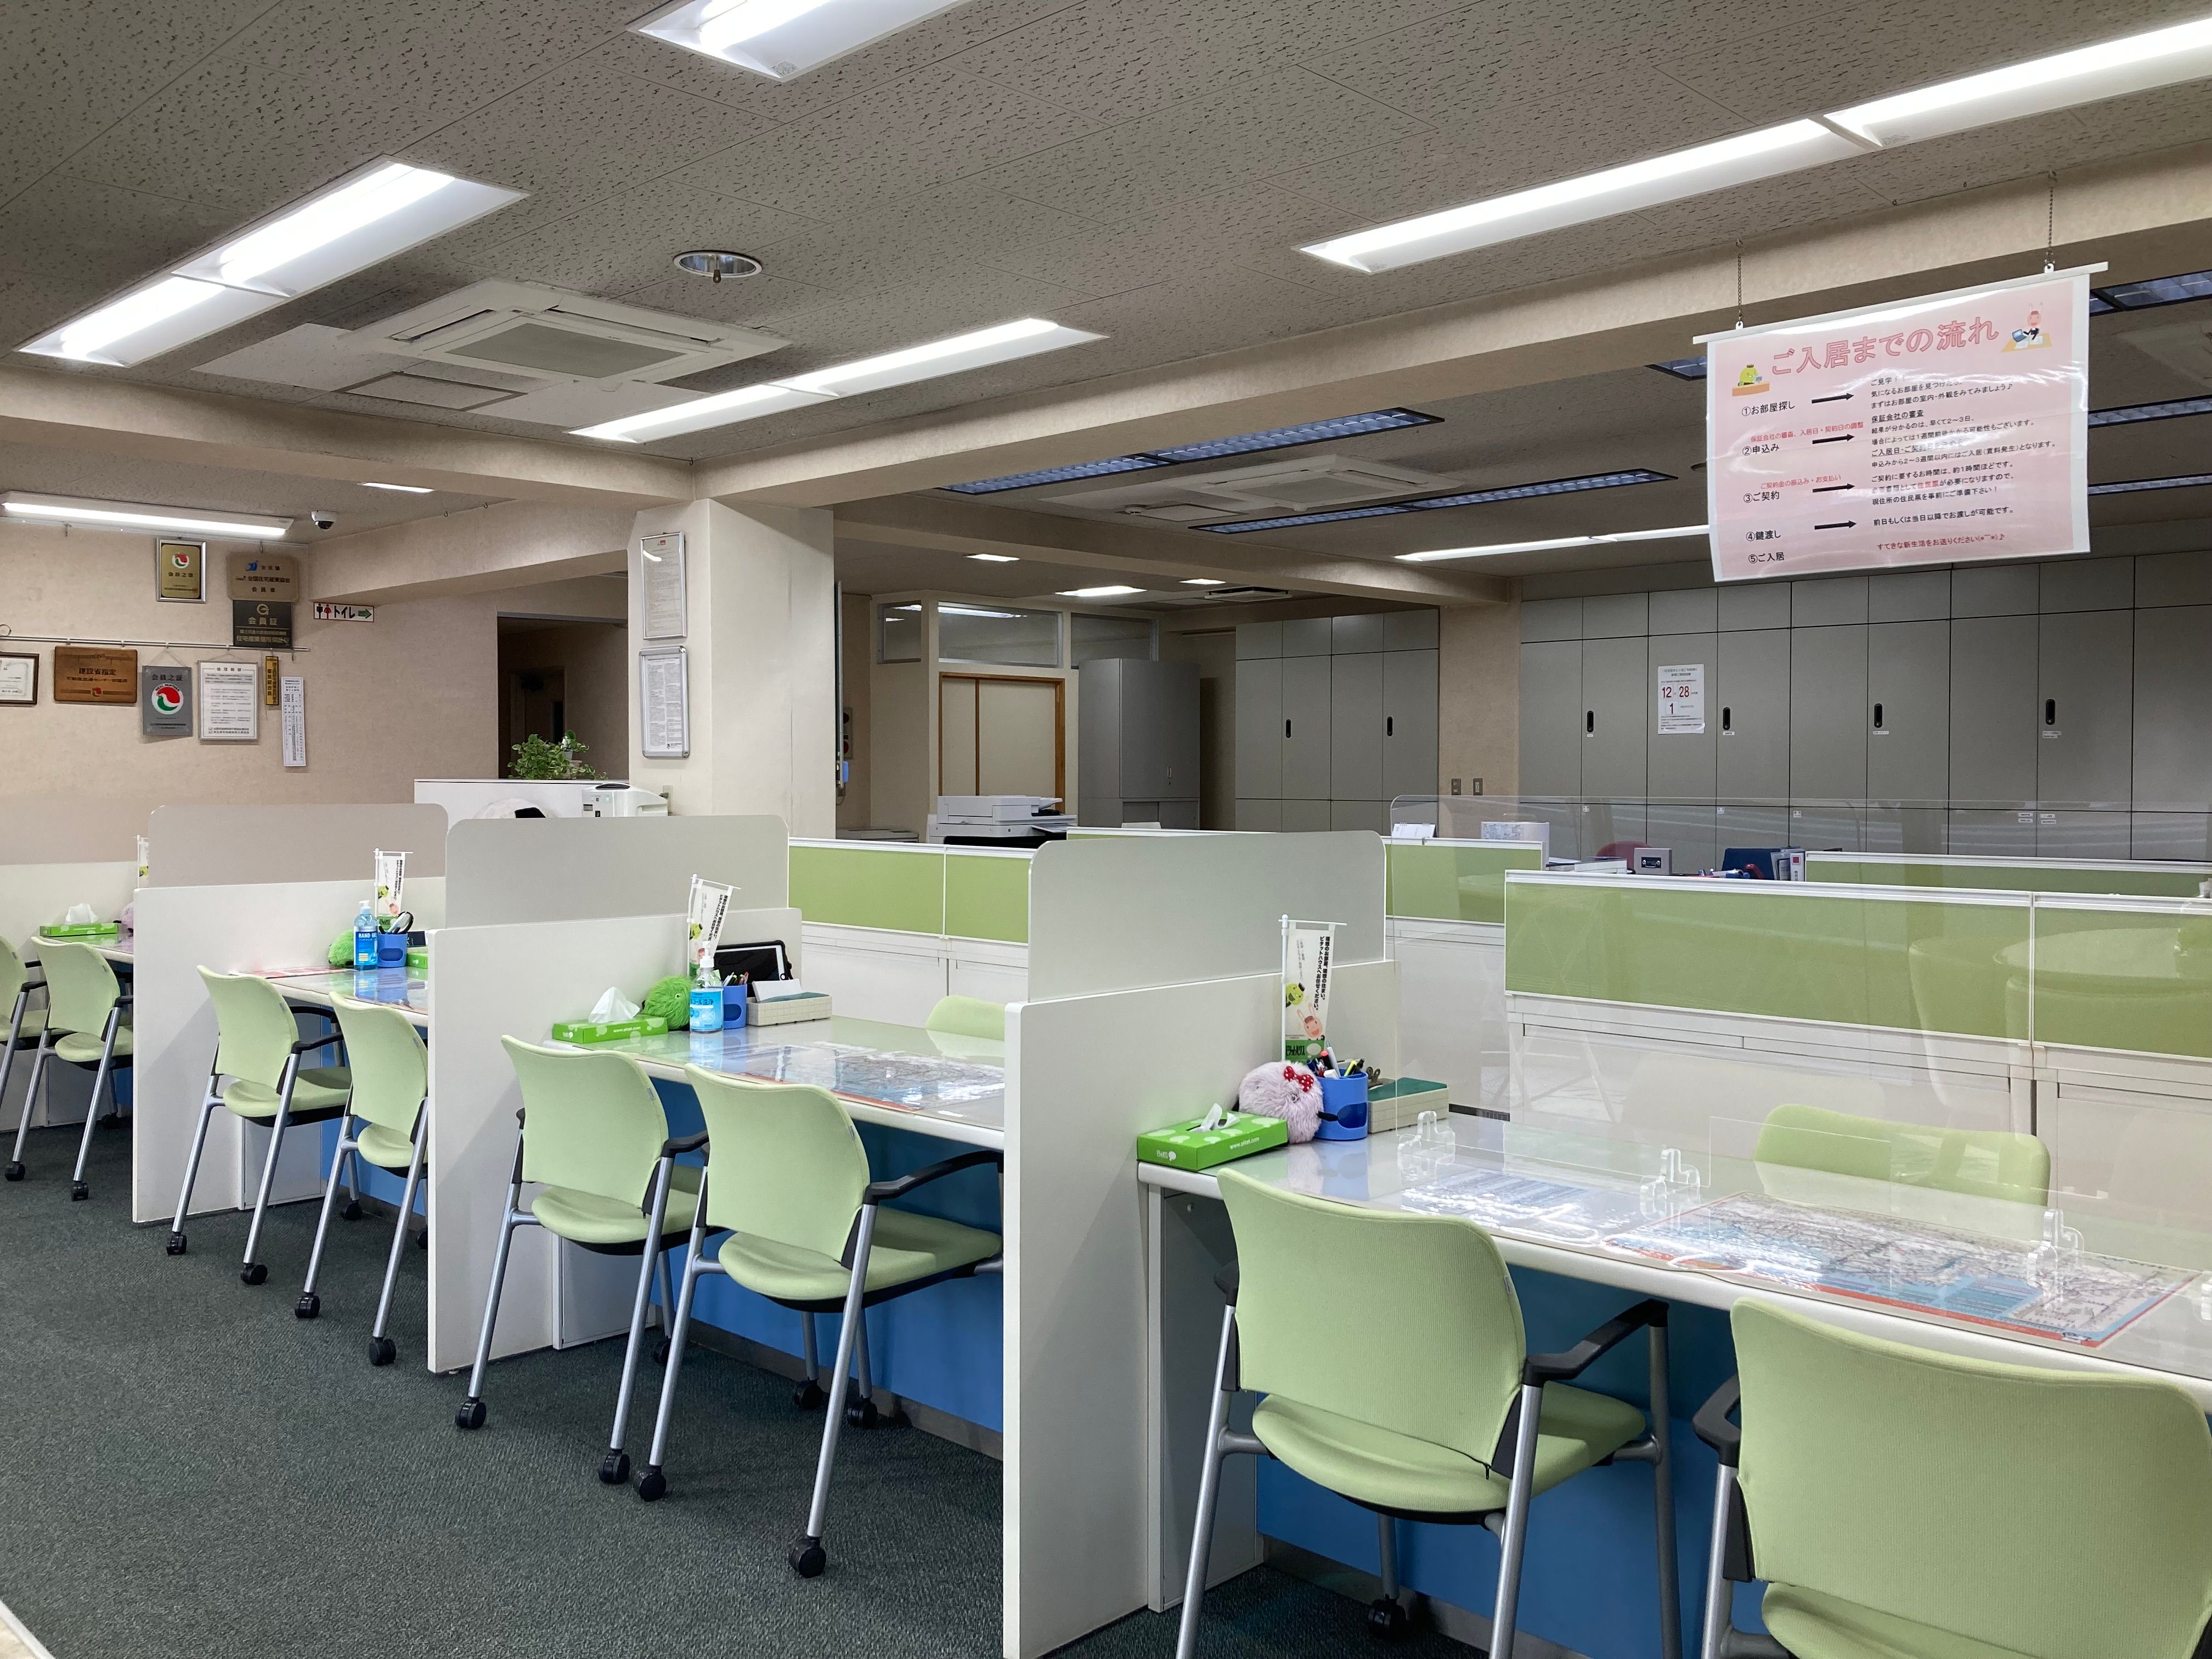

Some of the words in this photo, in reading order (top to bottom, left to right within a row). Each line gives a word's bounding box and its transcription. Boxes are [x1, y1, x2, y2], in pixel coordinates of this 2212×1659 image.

[1772, 317, 2000, 375] ご入居までの流れ
[1741, 401, 1796, 417] ①お部屋探し
[1871, 410, 1924, 424] 保証会社の審査
[1742, 443, 1780, 456] ②申込み
[1743, 491, 1780, 503] ③ご契約
[1874, 506, 2013, 526] 前日もしくは当日以降でお渡しが可能です。
[1746, 530, 1782, 541] ④鍵渡し
[1748, 552, 1785, 564] ⑤ご入居
[334, 606, 356, 619] トイレ
[1662, 687, 1672, 698] 12
[1679, 686, 1690, 697] 28
[1669, 703, 1673, 714] 1
